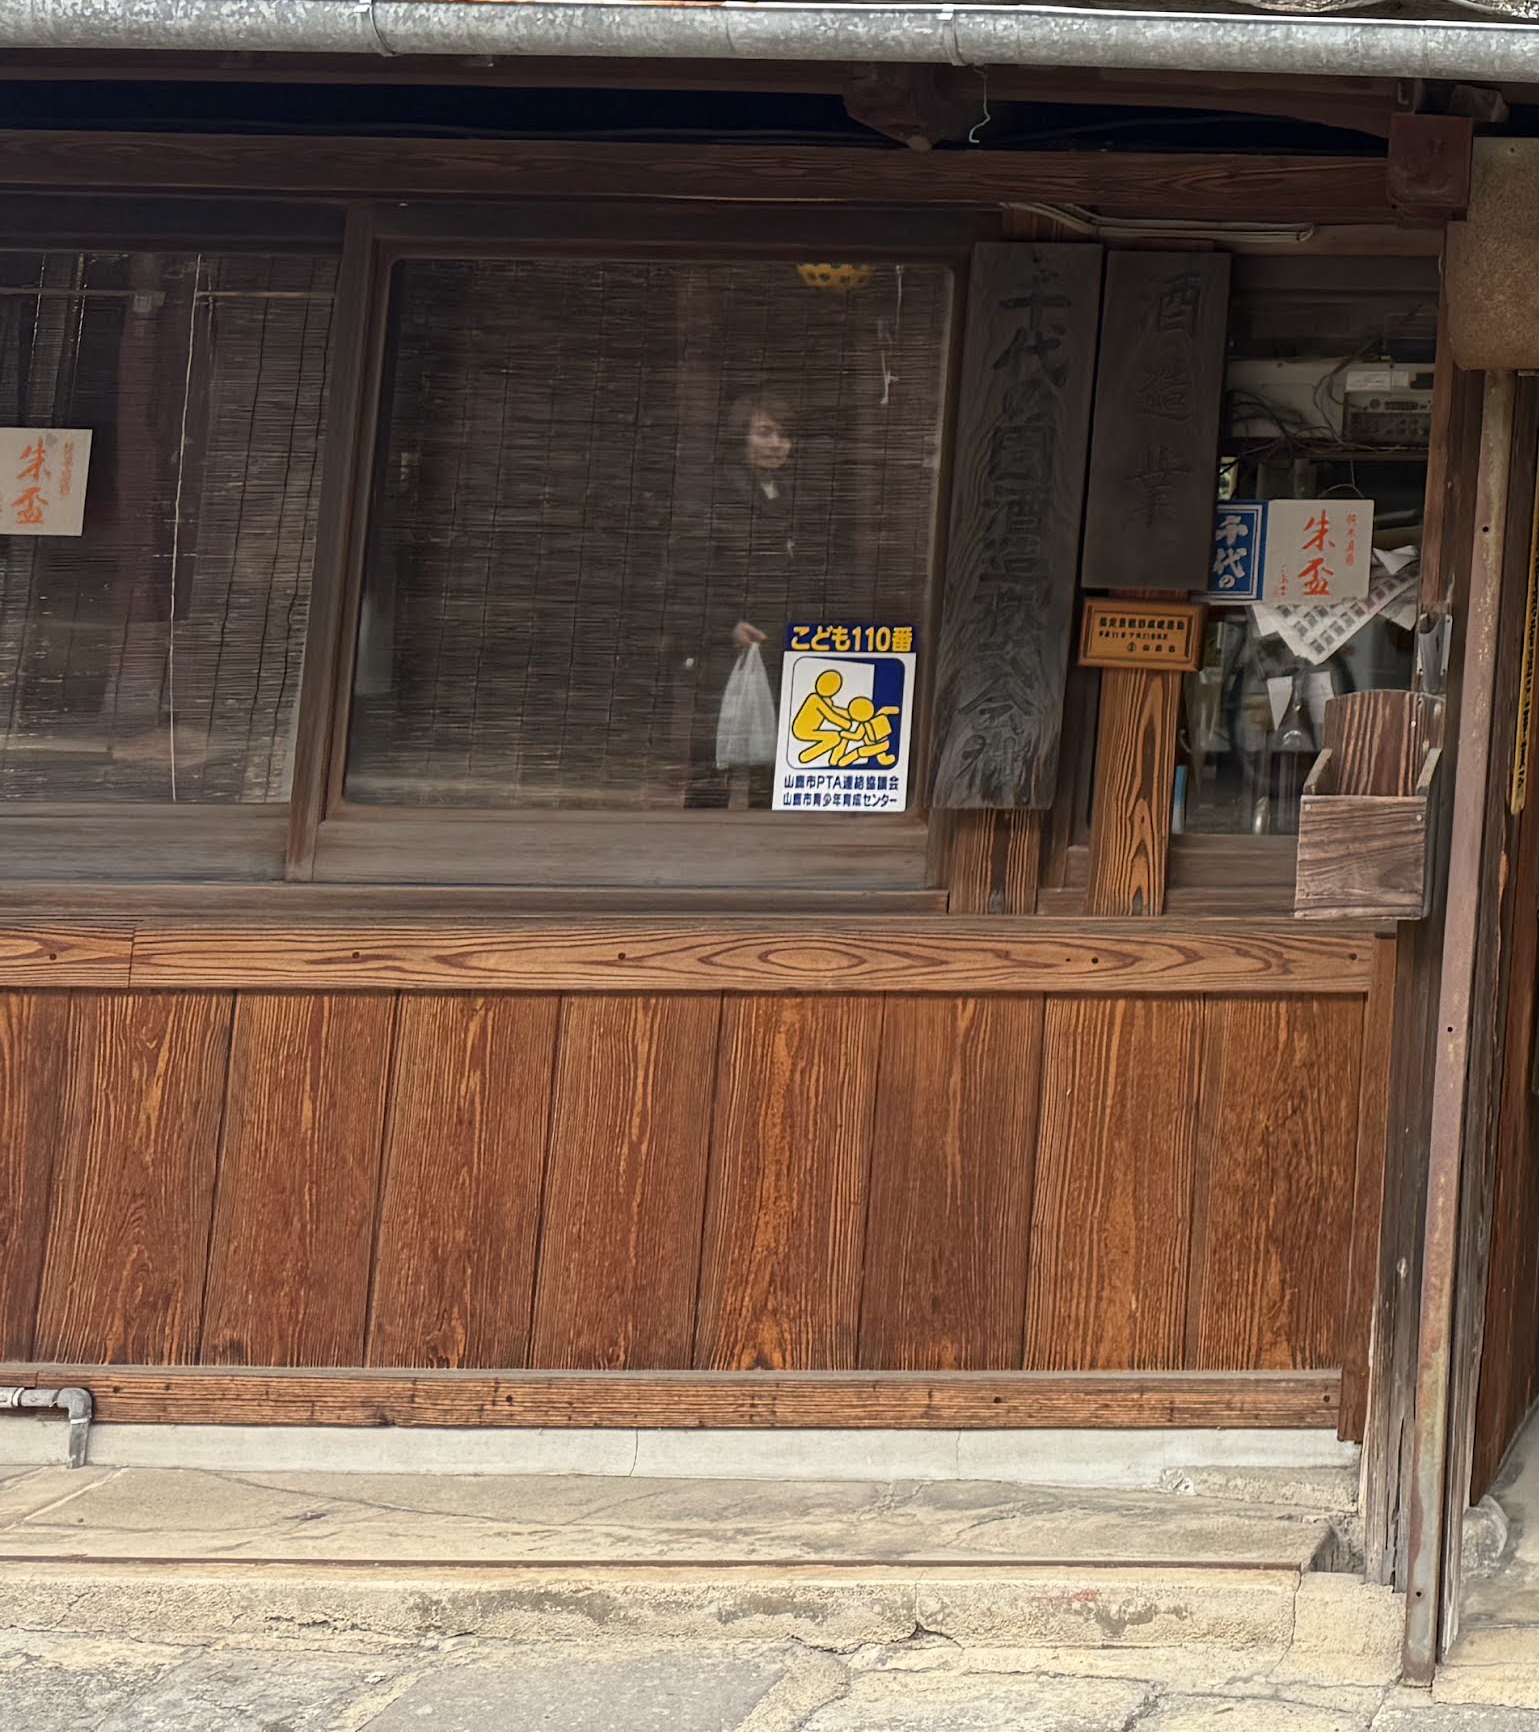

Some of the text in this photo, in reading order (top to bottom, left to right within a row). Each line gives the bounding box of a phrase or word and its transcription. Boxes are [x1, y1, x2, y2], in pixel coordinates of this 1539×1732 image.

[10, 436, 51, 524] 朱盃
[1298, 509, 1336, 596] 朱盃
[791, 625, 913, 652] こども110番
